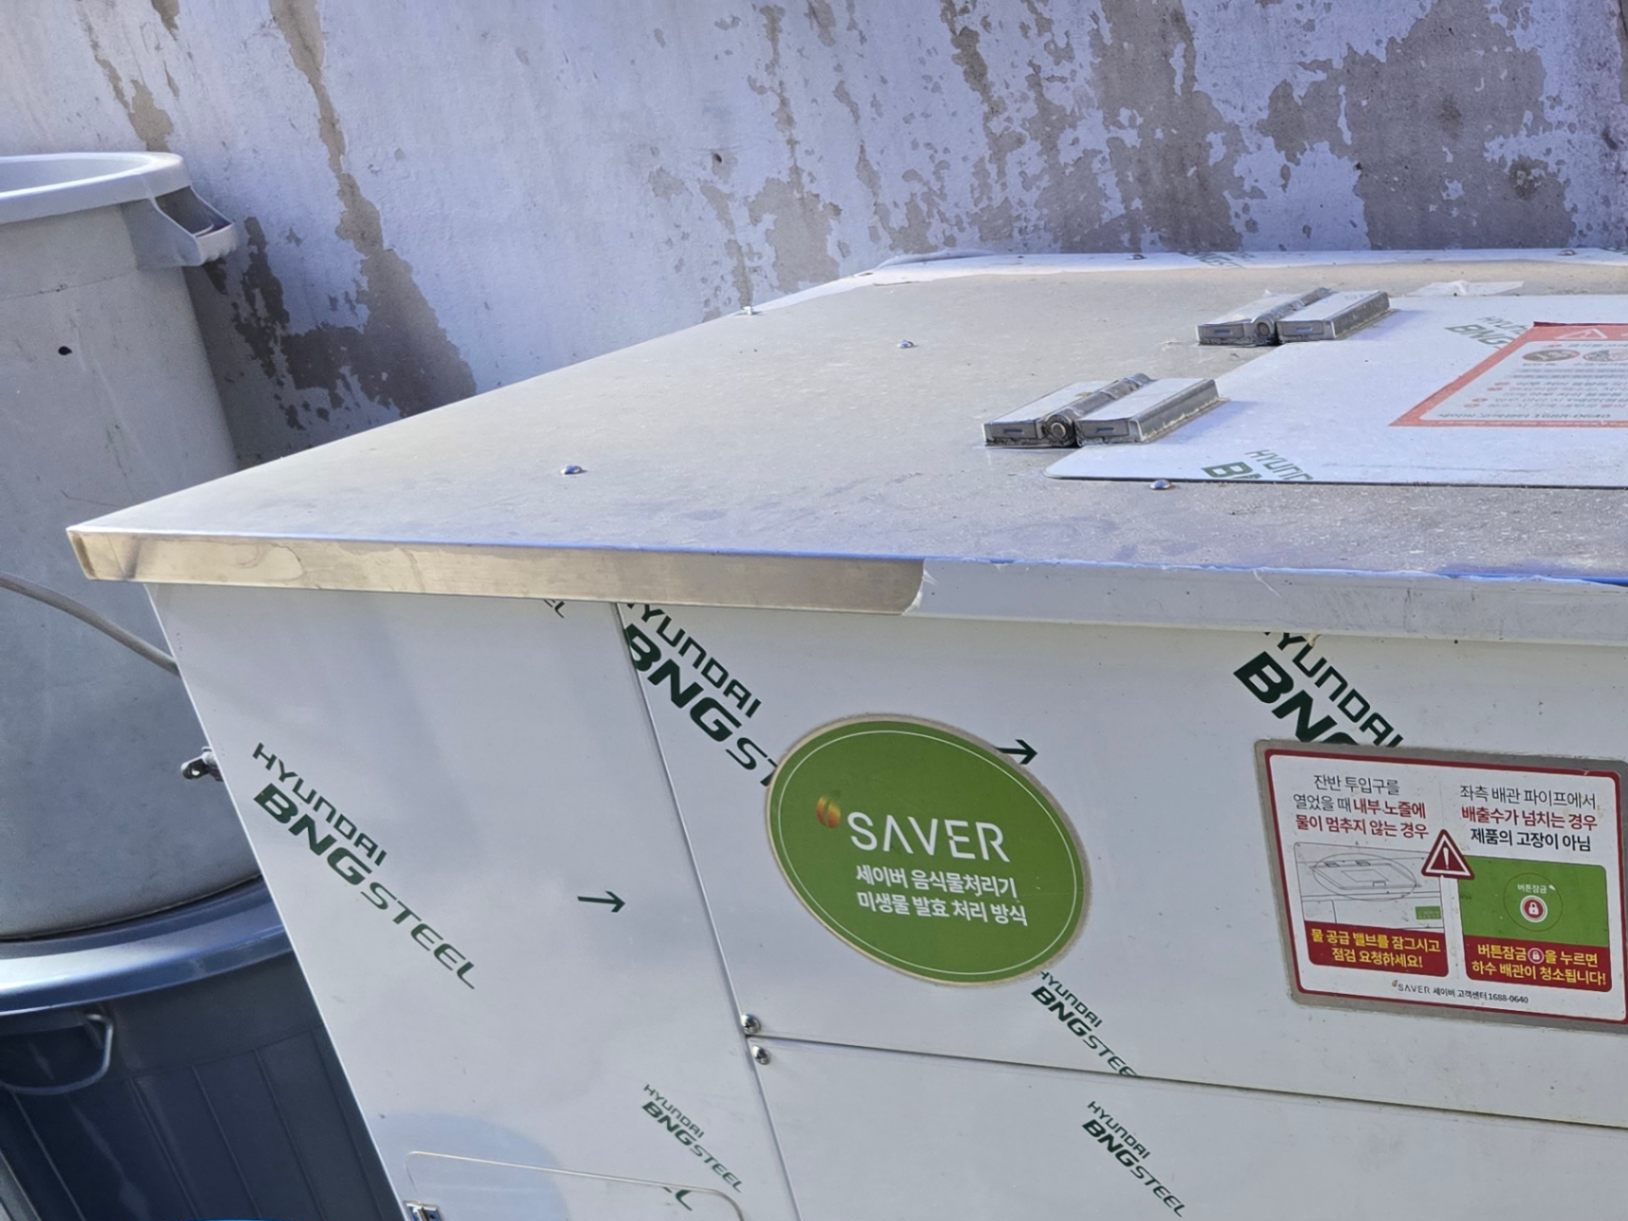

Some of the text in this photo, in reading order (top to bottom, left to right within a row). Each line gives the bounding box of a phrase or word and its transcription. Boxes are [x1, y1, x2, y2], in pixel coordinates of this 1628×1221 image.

[627, 603, 762, 719] YUNDAI
[1264, 632, 1404, 748] YUNDAI
[1314, 774, 1400, 796] 잔반 투입구를
[1459, 784, 1596, 810] 좌측 배관 파이프에서
[252, 742, 388, 867] HYUNDAI
[1293, 793, 1426, 819] 열었을 때 내부 노즐에
[1295, 814, 1429, 840] 물이 멈추지 않는 경우
[1461, 805, 1598, 831] 배출수가 넘치는 경우
[847, 811, 1010, 863] SAVER
[1470, 828, 1592, 852] 제품의 고장이 아님
[856, 864, 1018, 899] 세이버 음식물처리기
[856, 891, 1028, 927] 미생물 발효 처리 방식
[1326, 930, 1350, 944] 공급
[1392, 936, 1441, 953] 잠그시고
[1332, 947, 1423, 968] 점검 요청하세요!
[1560, 951, 1598, 967] 누르면
[1471, 961, 1606, 986] 하수 배관이 청소됩니다!
[1398, 983, 1430, 994] SAVER
[1457, 989, 1488, 1001] 고객센터
[643, 1084, 704, 1138] HYUNDAI
[1088, 1101, 1150, 1159] HYUNDAI
